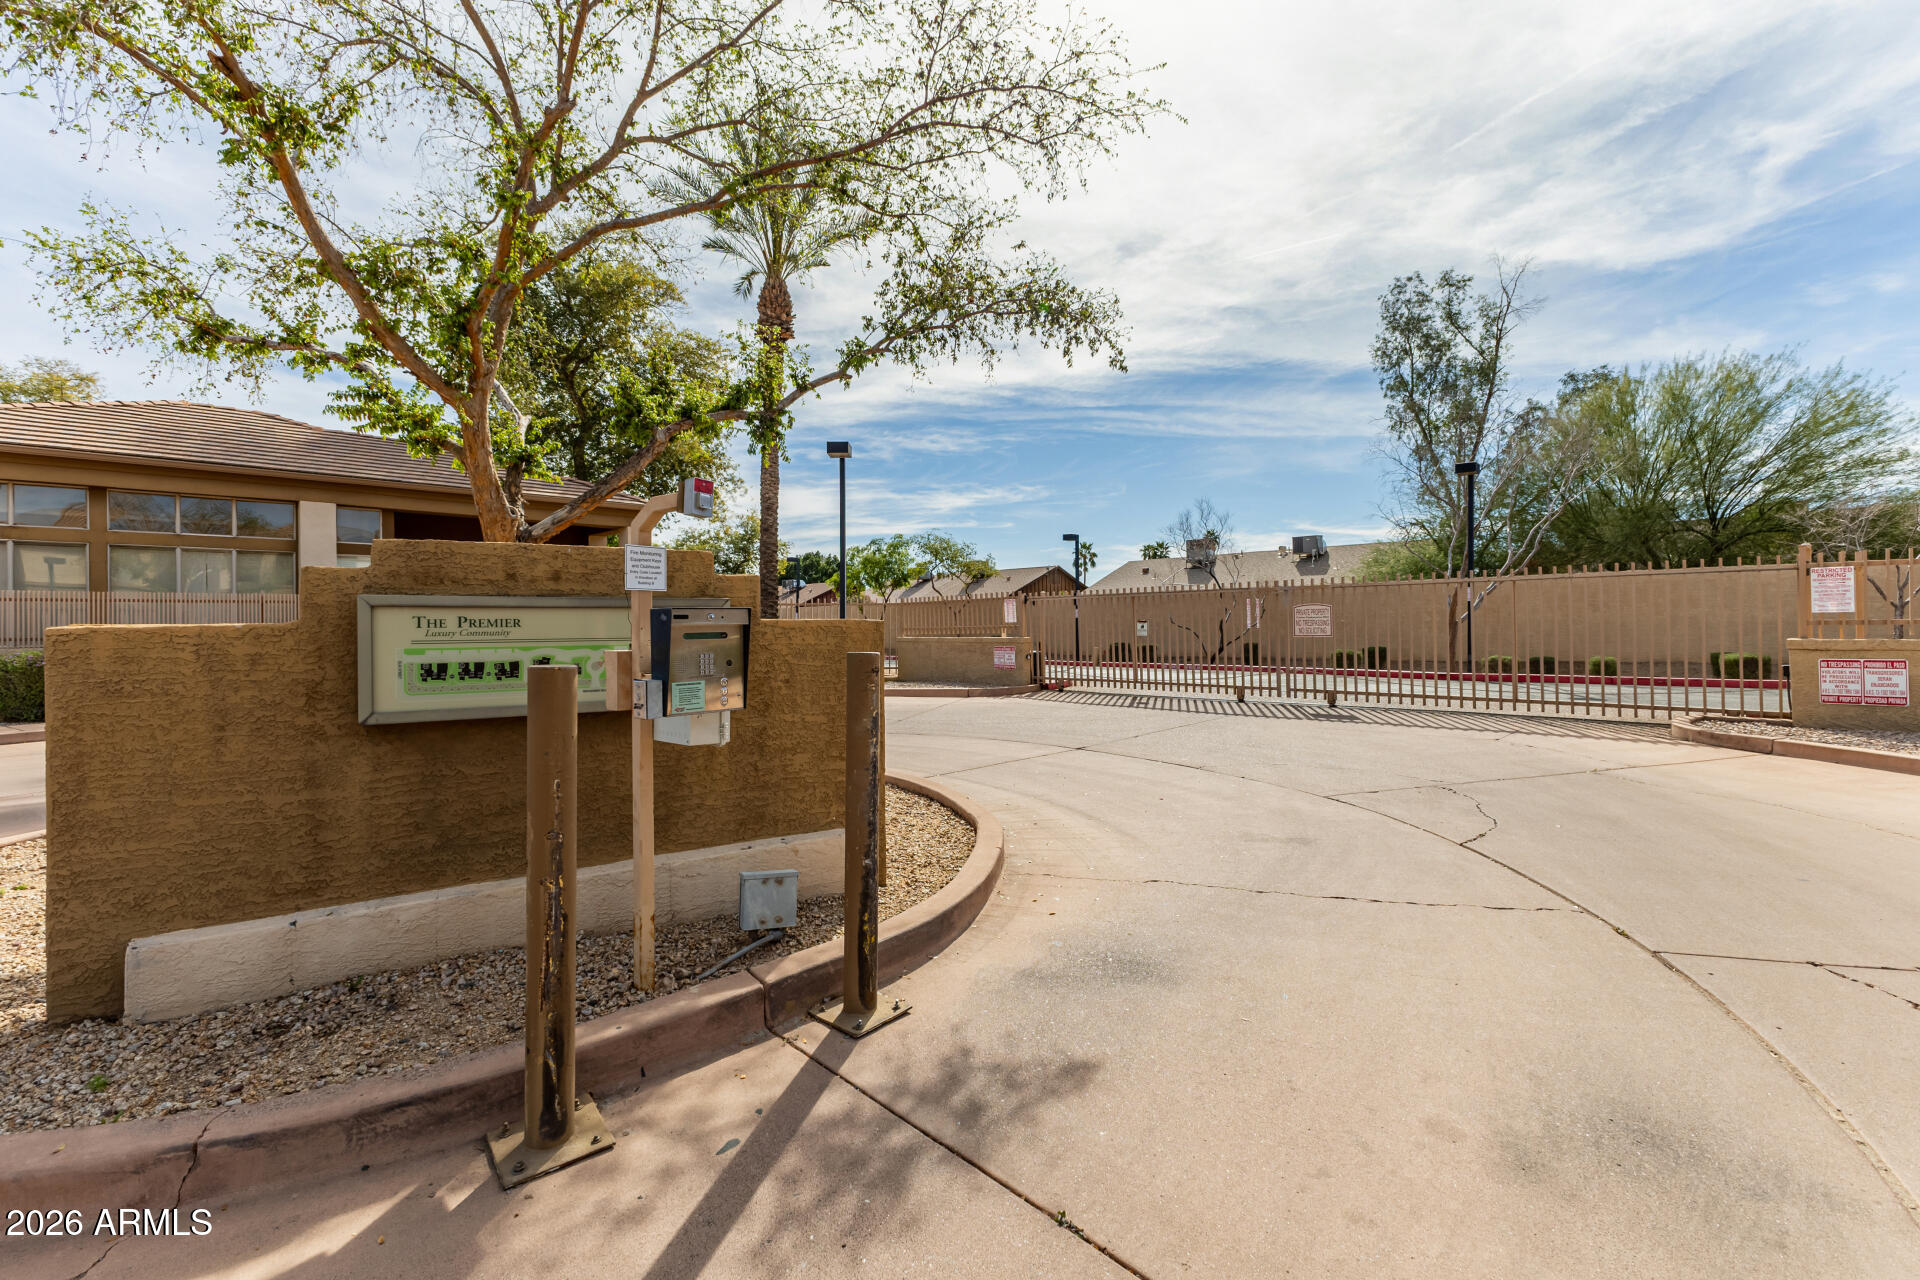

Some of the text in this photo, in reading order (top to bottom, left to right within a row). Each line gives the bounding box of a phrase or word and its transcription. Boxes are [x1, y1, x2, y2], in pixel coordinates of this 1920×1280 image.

[412, 616, 522, 628] THE PREMIER
[425, 628, 512, 638] Luxury Community
